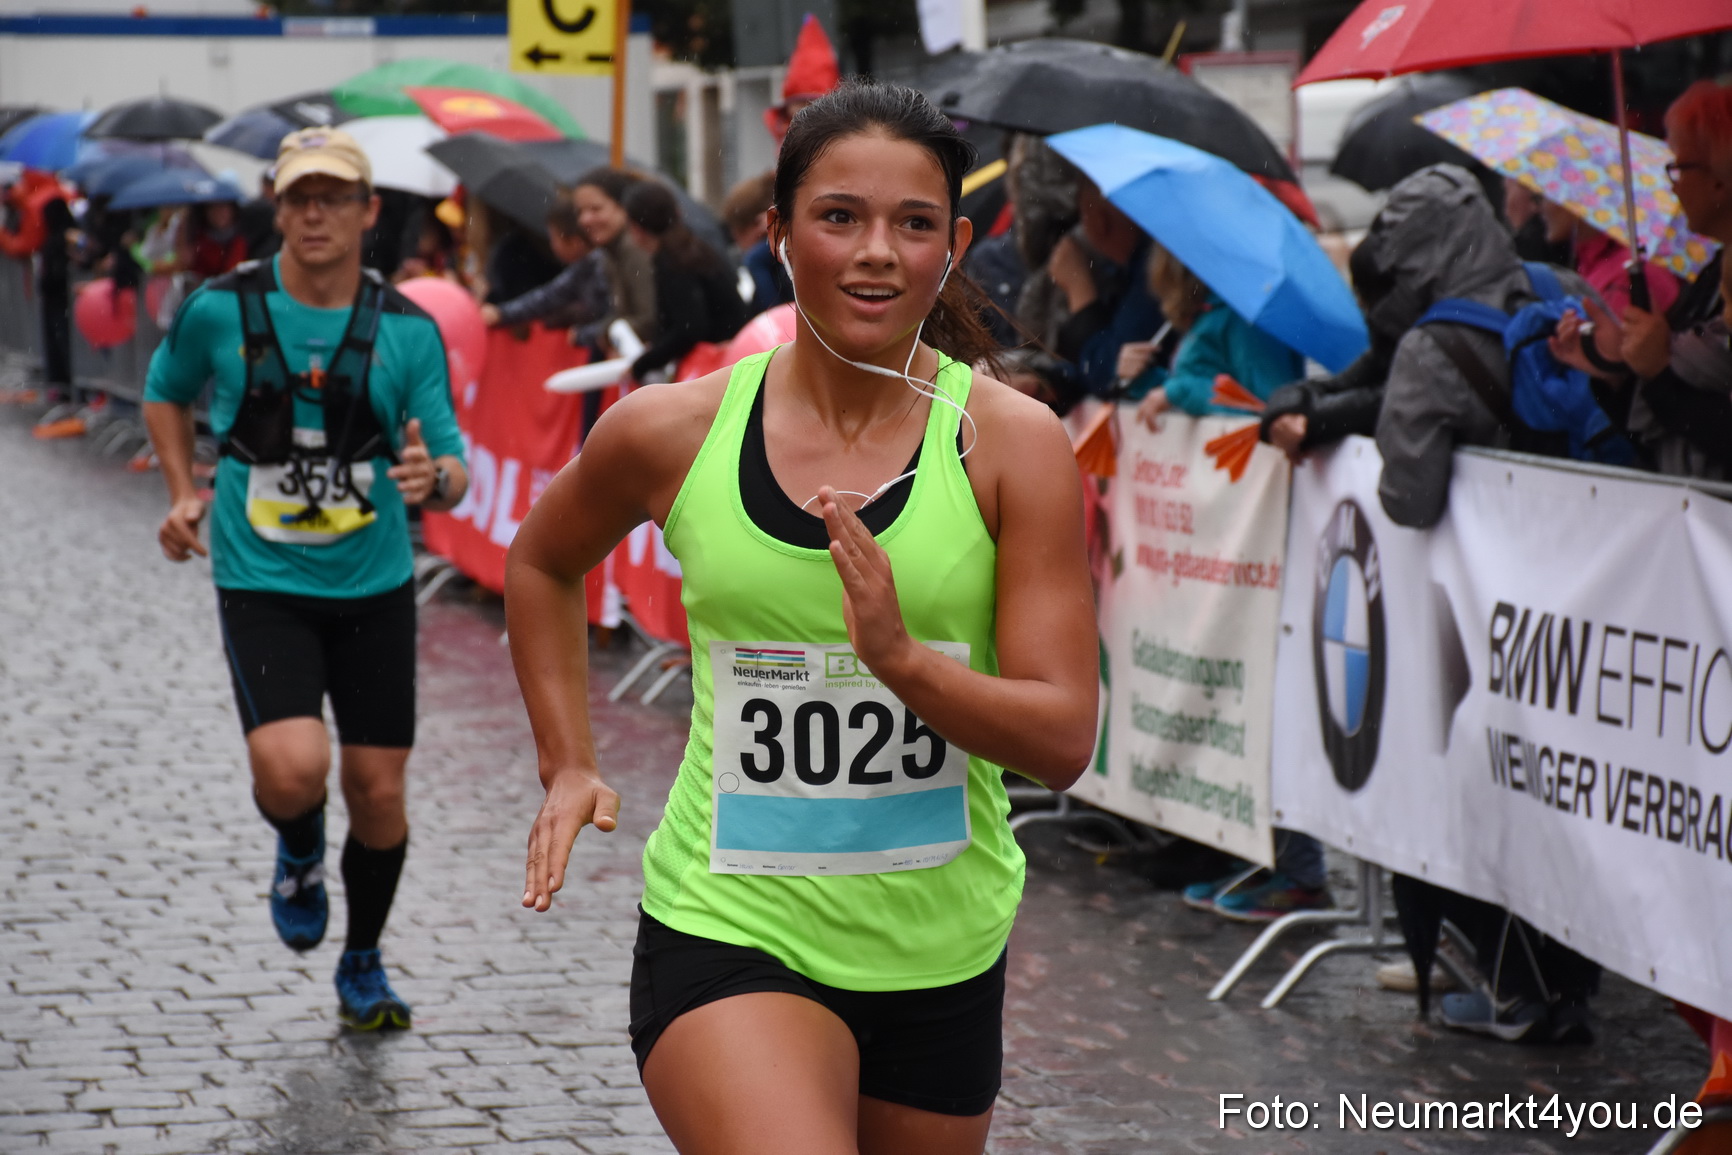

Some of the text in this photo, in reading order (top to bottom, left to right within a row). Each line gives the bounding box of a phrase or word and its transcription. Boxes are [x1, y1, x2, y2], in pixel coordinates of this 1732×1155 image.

[733, 666, 810, 682] NeuerMarkt
[1489, 601, 1592, 716] BMW
[825, 680, 863, 689] inspired
[865, 680, 876, 690] by
[740, 698, 947, 786] 3025
